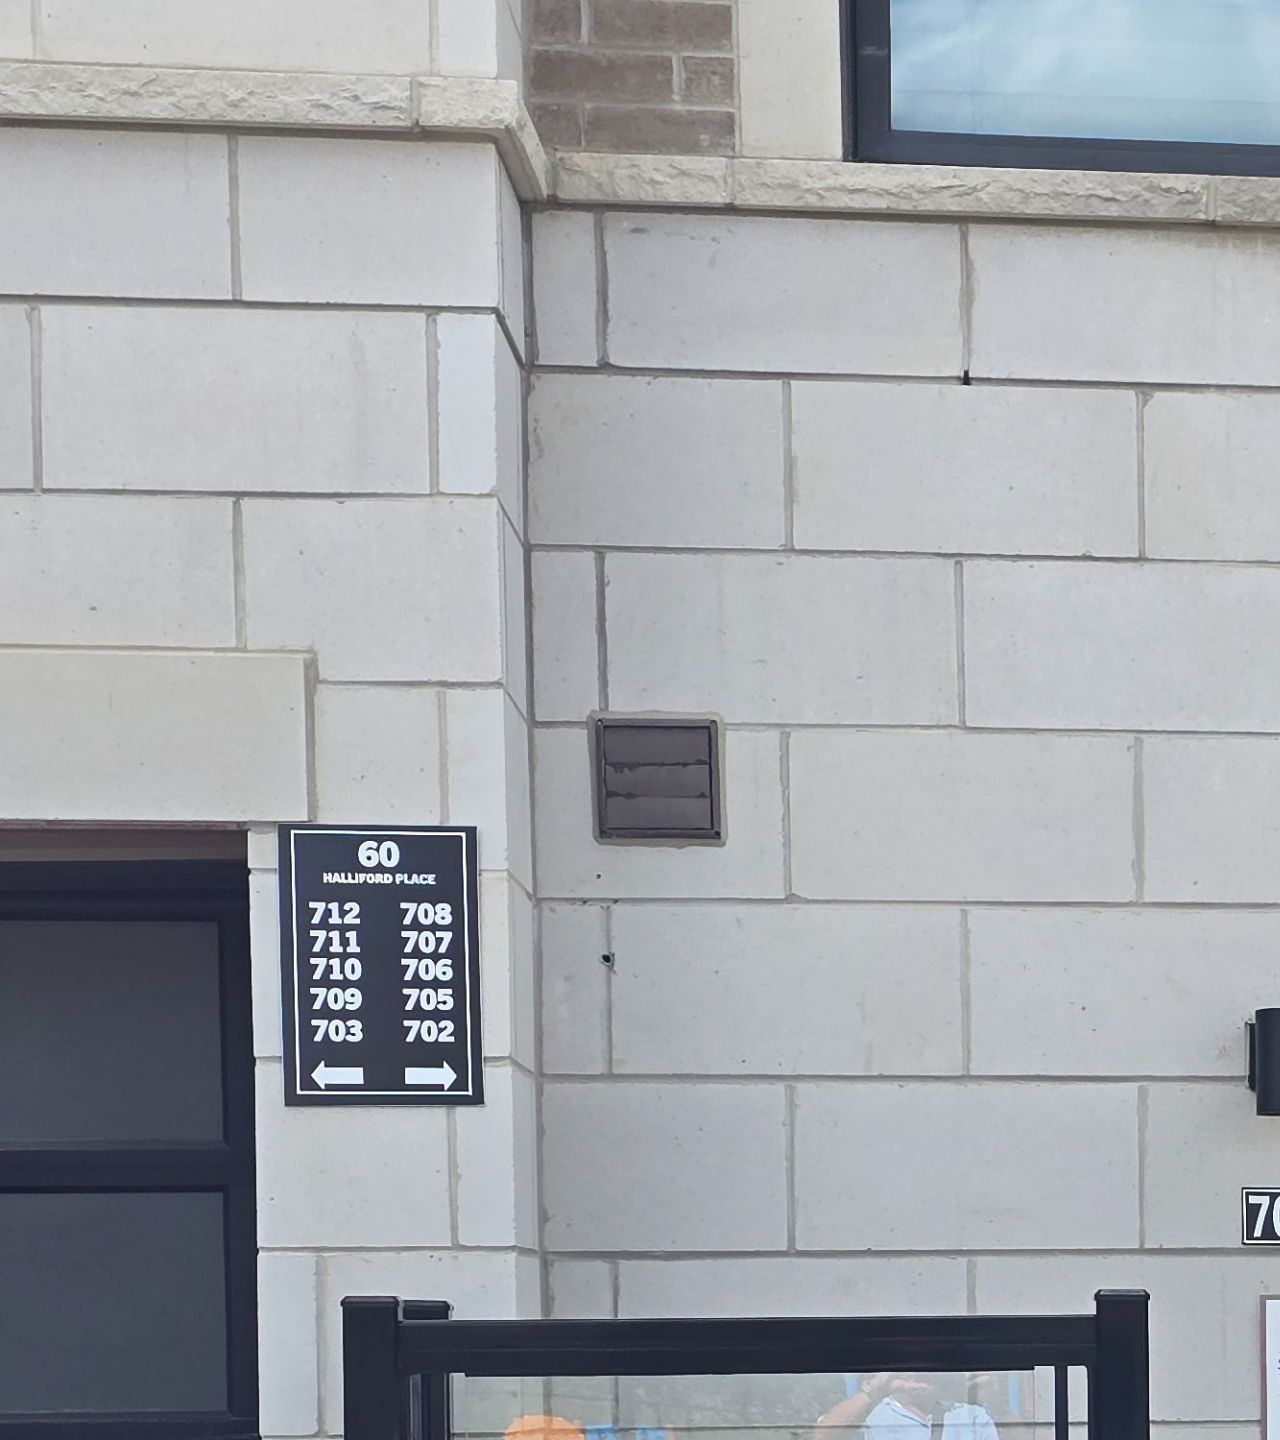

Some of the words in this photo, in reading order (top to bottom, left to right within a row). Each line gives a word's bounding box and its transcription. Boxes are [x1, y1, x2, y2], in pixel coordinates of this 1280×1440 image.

[358, 841, 399, 867] 60
[323, 872, 392, 884] HALLIFORD
[395, 873, 436, 885] PLACE
[308, 901, 361, 925] 712
[400, 902, 452, 925] 708
[309, 930, 361, 953] 711
[401, 930, 453, 953] 707
[309, 957, 362, 981] 710
[400, 958, 453, 981] 706
[309, 987, 362, 1010] 709
[402, 988, 454, 1011] 705
[310, 1019, 363, 1042] 703
[403, 1019, 455, 1043] 702
